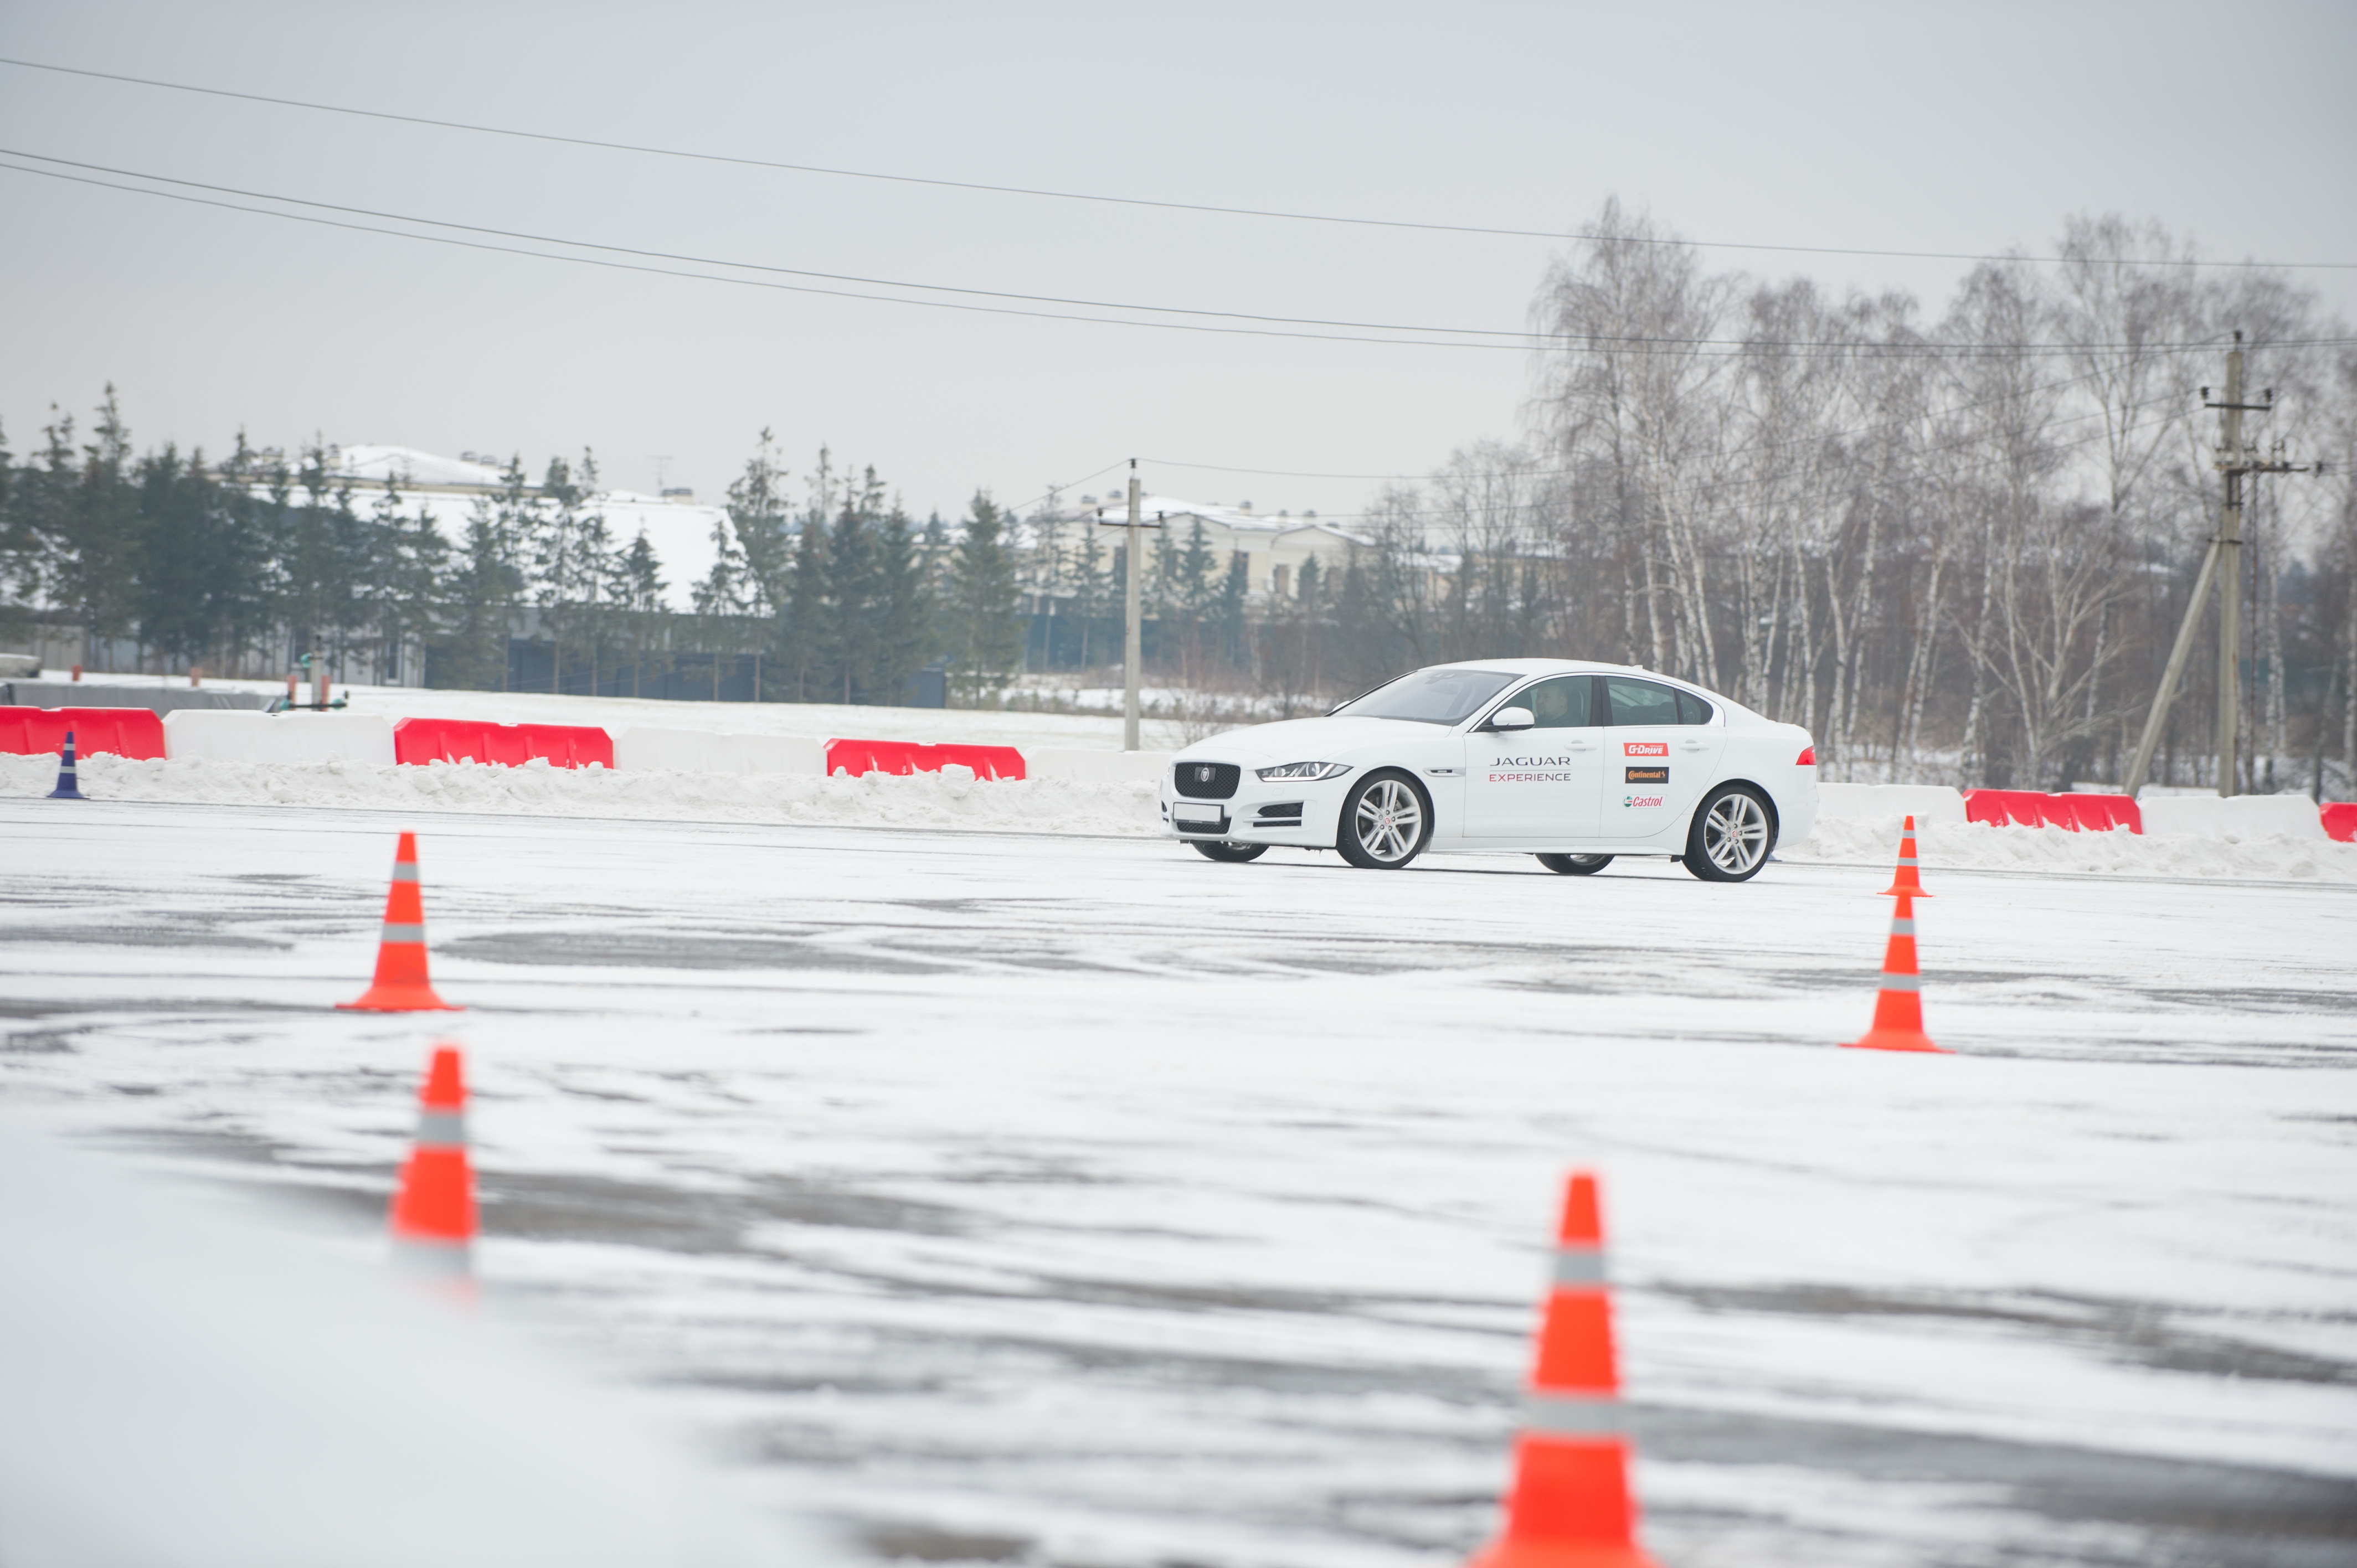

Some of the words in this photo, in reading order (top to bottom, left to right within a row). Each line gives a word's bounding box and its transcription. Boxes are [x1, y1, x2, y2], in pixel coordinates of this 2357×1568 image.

[1490, 757, 1571, 766] JAGUAR
[1628, 770, 1660, 780] Continental
[1633, 796, 1663, 807] Castrol
